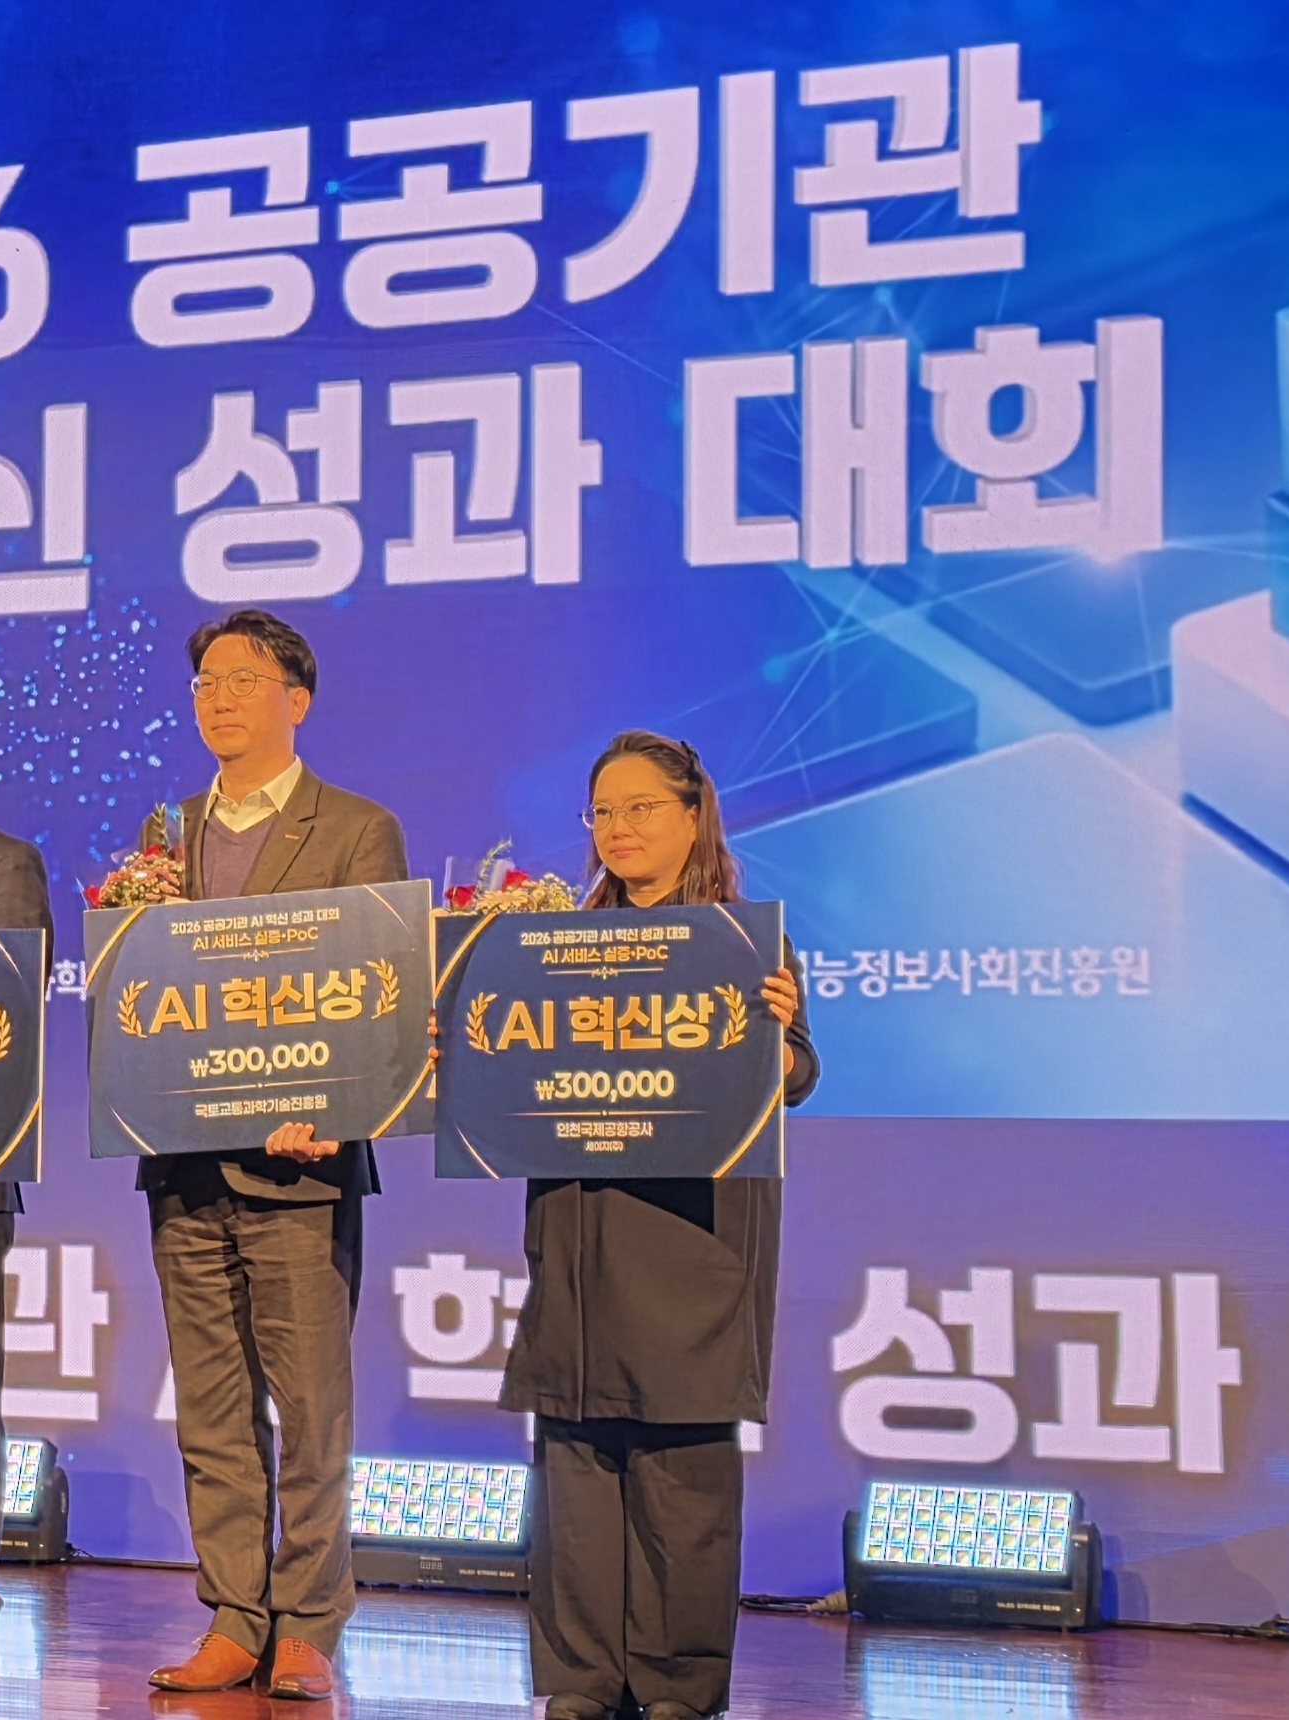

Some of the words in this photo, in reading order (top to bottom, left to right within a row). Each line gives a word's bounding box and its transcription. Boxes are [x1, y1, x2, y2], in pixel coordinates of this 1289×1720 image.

[126, 42, 1043, 349] 공공기관
[173, 359, 603, 603] 성과
[682, 314, 1164, 569] 대회
[171, 921, 201, 935] 2026
[203, 917, 248, 932] 공공기관
[250, 915, 263, 928] AI
[266, 912, 289, 926] 혁신
[291, 910, 314, 925] 성과
[521, 932, 551, 946] 2026
[553, 930, 598, 944] 공공기관
[600, 930, 613, 942] AI
[615, 928, 639, 942] 혁신
[641, 927, 664, 941] 성과
[193, 936, 209, 950] AI
[213, 933, 252, 949] 서비스
[542, 949, 559, 964] AI
[561, 947, 602, 964] 서비스
[149, 984, 207, 1035] AI
[221, 968, 367, 1028] 혁신상
[496, 1000, 554, 1050] AI
[568, 992, 715, 1051] 혁신상
[190, 1041, 330, 1078] ₩300,000
[535, 1069, 676, 1104] ₩300,000
[195, 1094, 327, 1119] 국토교통과학기술진흥원
[556, 1121, 654, 1138] 인천국제공항공사
[831, 1267, 1242, 1474] 성과
